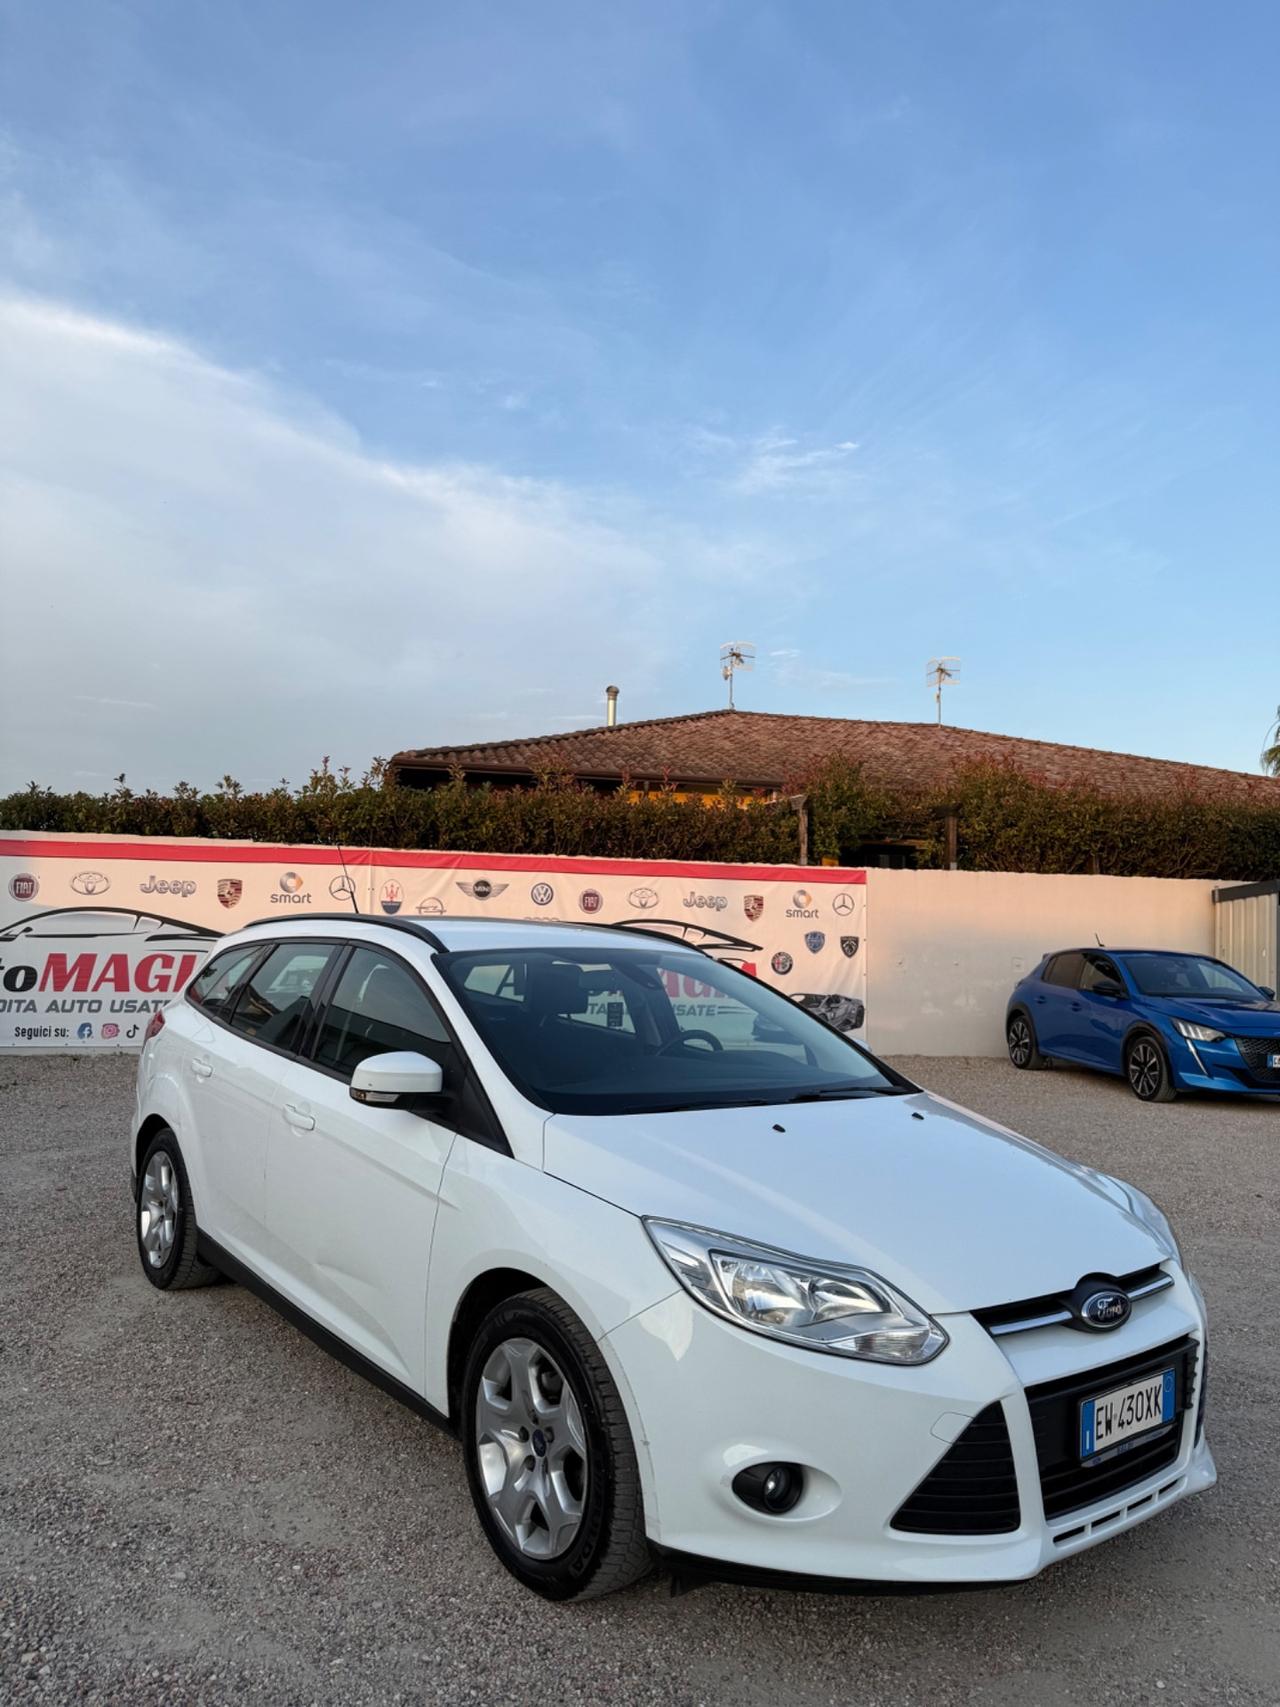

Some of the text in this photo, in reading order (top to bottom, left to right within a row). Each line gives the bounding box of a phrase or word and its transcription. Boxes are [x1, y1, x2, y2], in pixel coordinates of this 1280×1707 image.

[15, 881, 34, 895] FIAT
[140, 876, 197, 897] Jeep
[270, 892, 312, 904] smart
[683, 891, 728, 911] Jeep
[786, 908, 819, 919] smart
[45, 999, 101, 1013] AUTO
[14, 1026, 70, 1039] Seguici su:
[1097, 1298, 1121, 1320] Ford
[1095, 1384, 1162, 1440] EW 430XK
